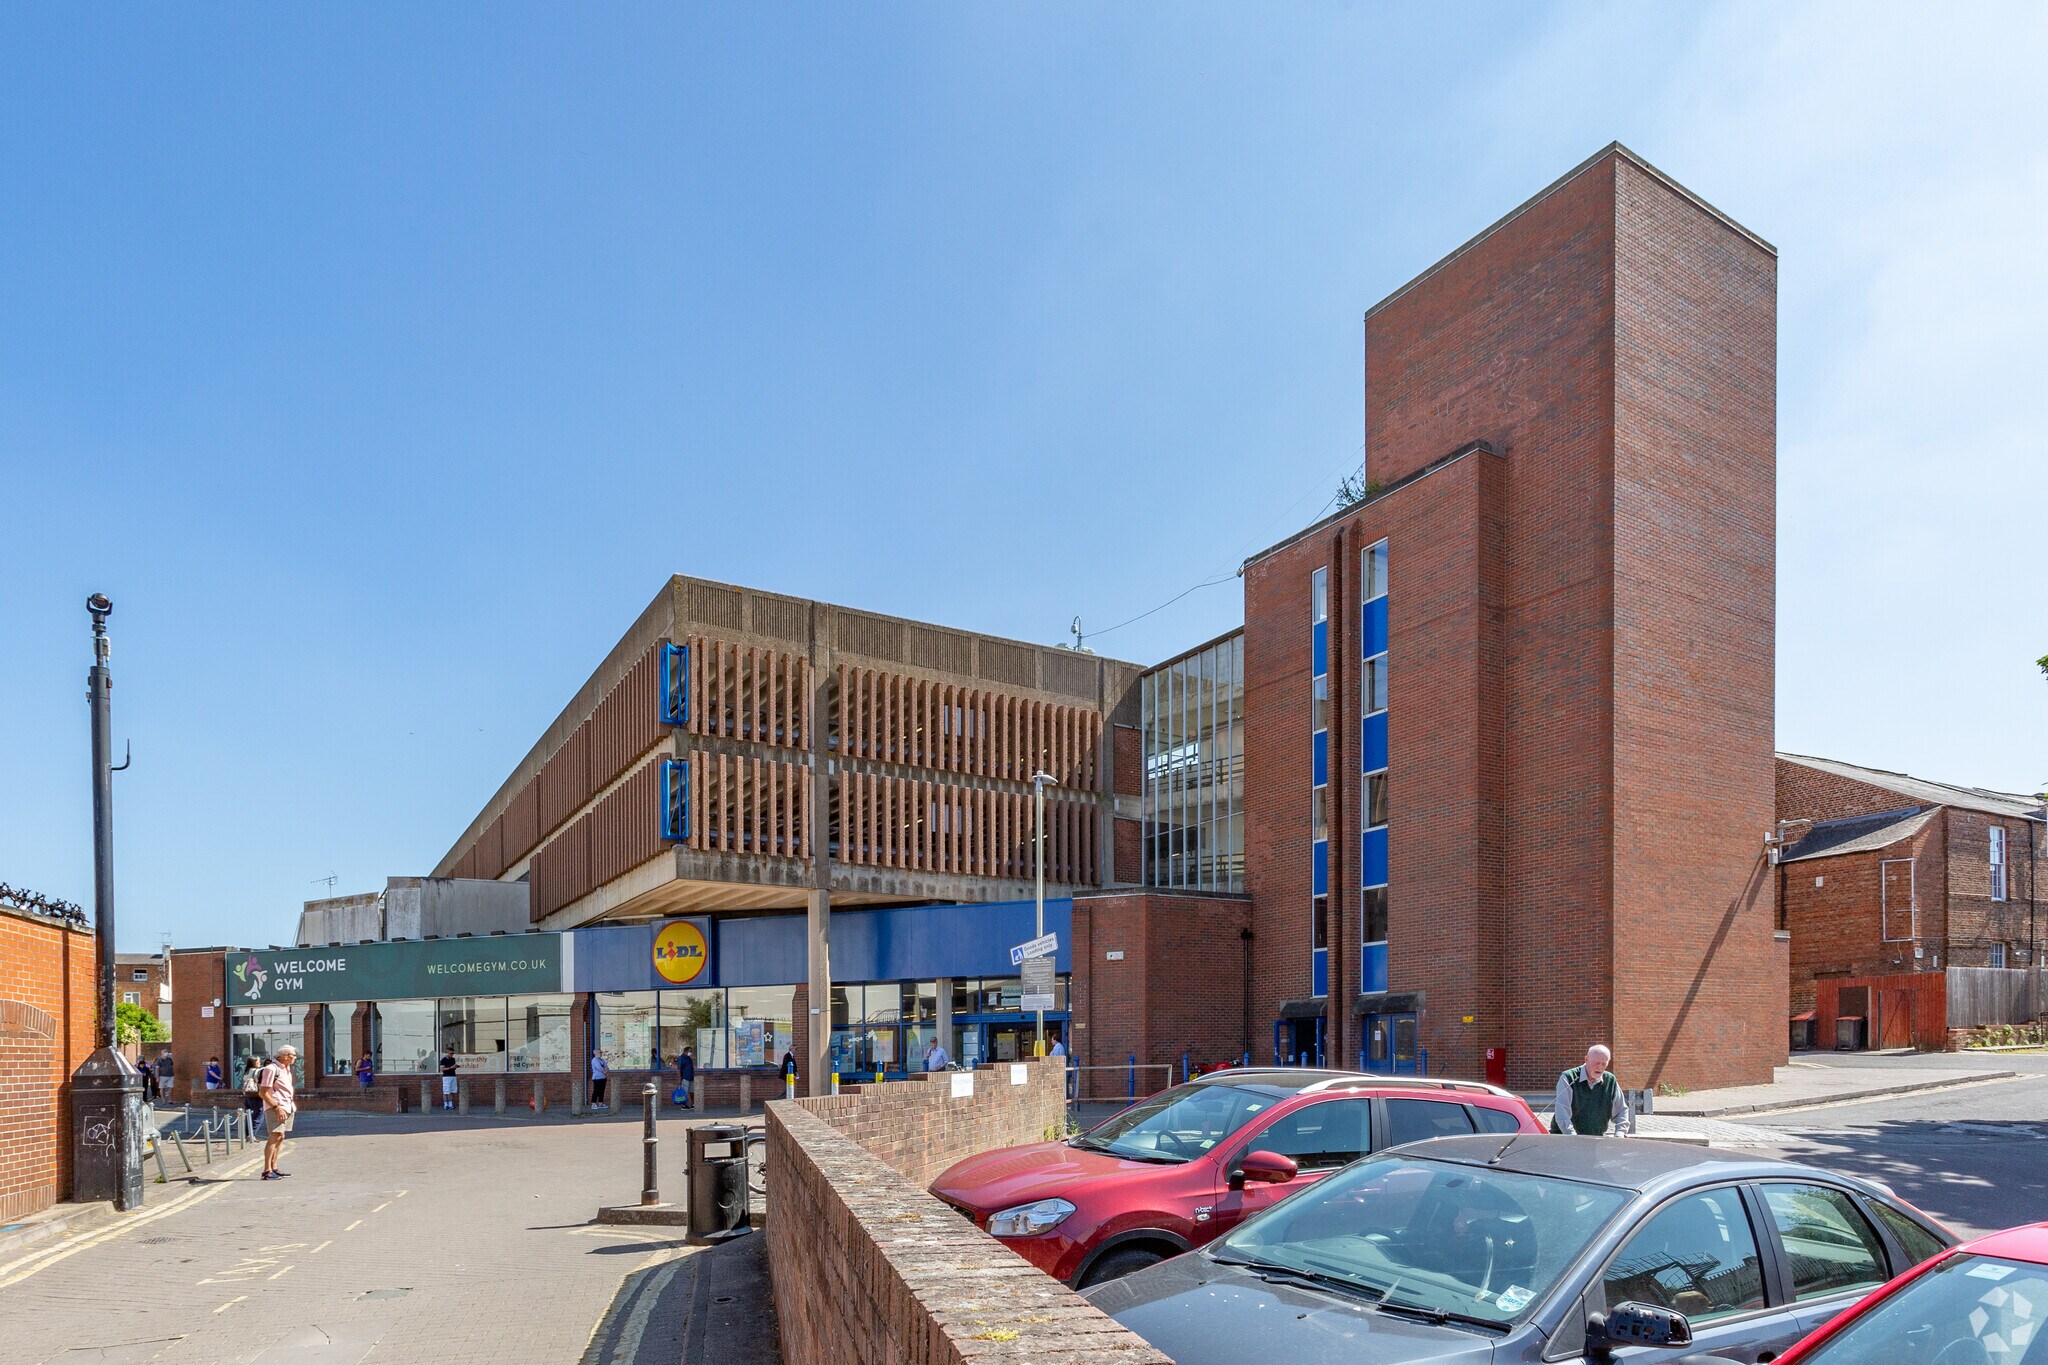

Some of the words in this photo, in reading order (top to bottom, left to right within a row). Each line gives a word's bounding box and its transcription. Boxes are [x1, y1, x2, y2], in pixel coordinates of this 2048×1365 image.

[1024, 944, 1036, 952] Goods
[1038, 938, 1054, 947] vehicles
[1026, 947, 1043, 956] Loading
[1044, 943, 1053, 951] only
[274, 958, 346, 974] WELCOME
[427, 959, 546, 974] WELCOMEGYM.CO.UK
[274, 978, 303, 991] GYM
